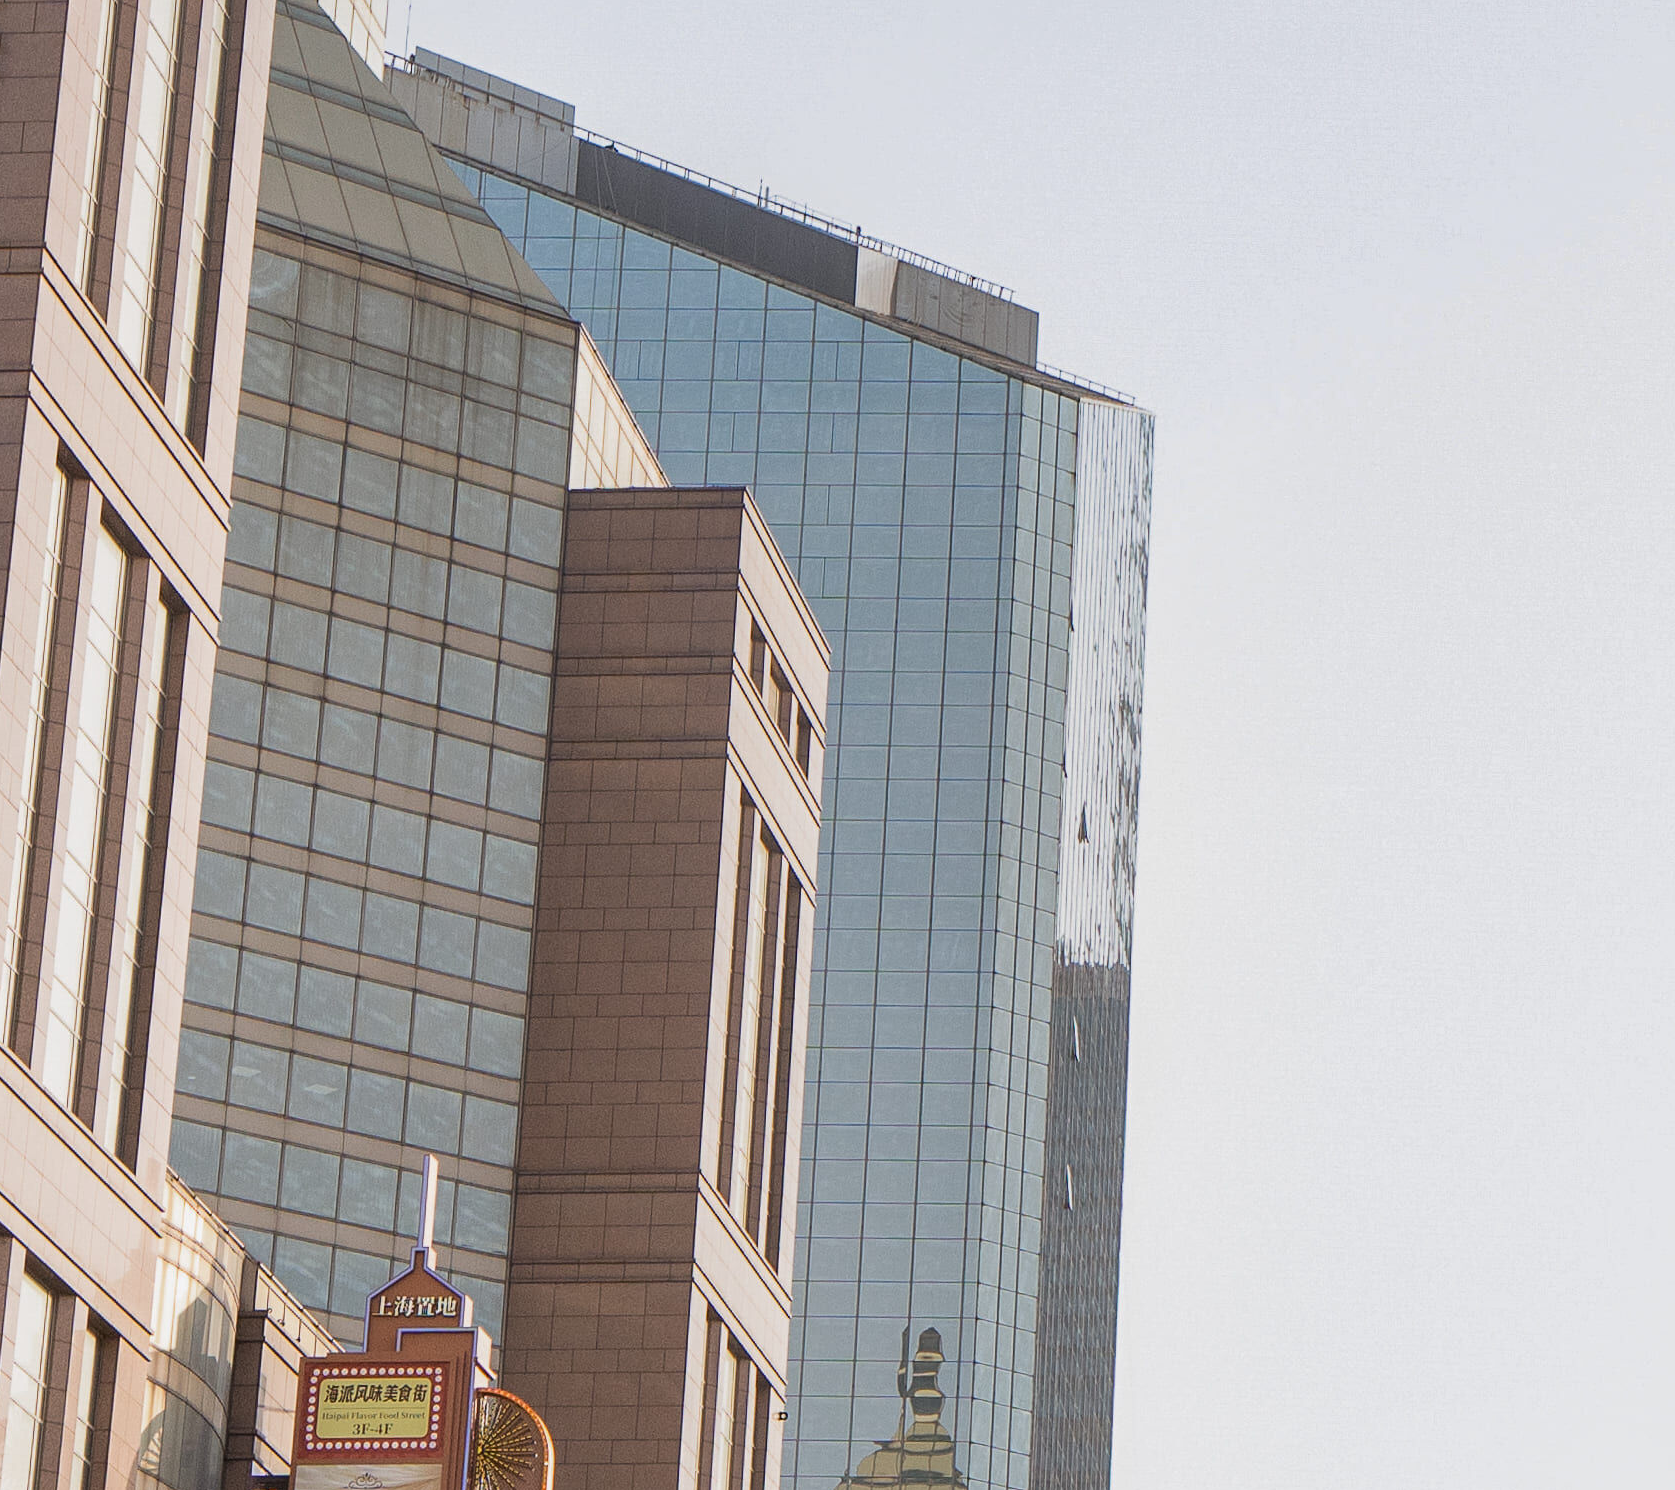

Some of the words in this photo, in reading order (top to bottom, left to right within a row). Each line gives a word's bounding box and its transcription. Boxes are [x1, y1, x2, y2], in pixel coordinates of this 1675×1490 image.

[371, 1295, 458, 1318] 上海置地
[323, 1384, 428, 1403] 海派风味美食街
